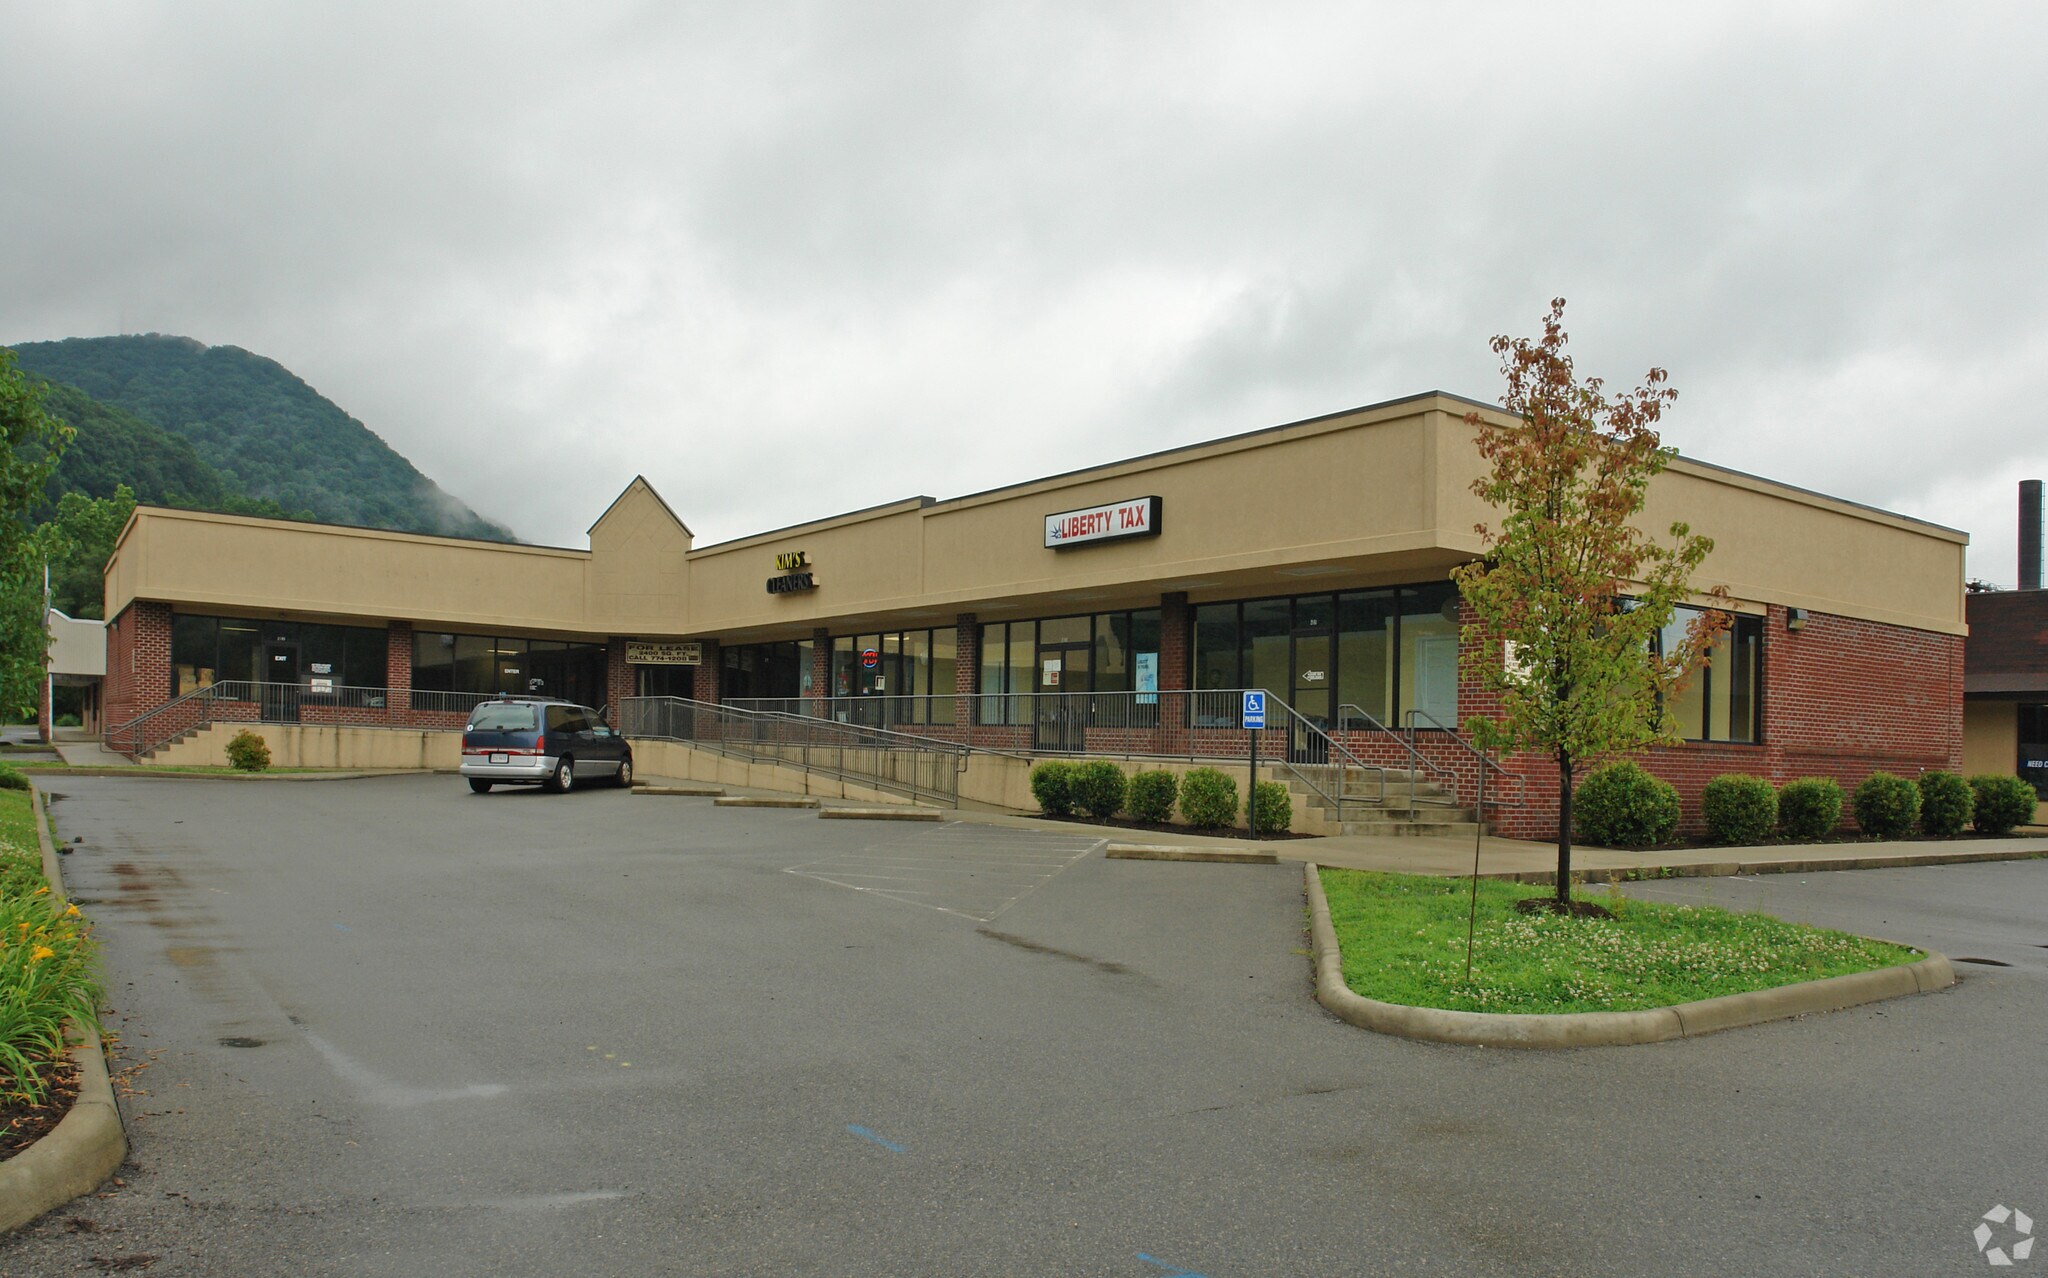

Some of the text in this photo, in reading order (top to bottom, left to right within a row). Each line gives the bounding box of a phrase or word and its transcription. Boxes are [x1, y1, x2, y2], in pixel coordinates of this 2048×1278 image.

[1061, 505, 1144, 539] LIBERTY TAX
[776, 552, 803, 570] KIM'S
[1244, 715, 1264, 723] PARKING
[2027, 760, 2043, 768] NEED
